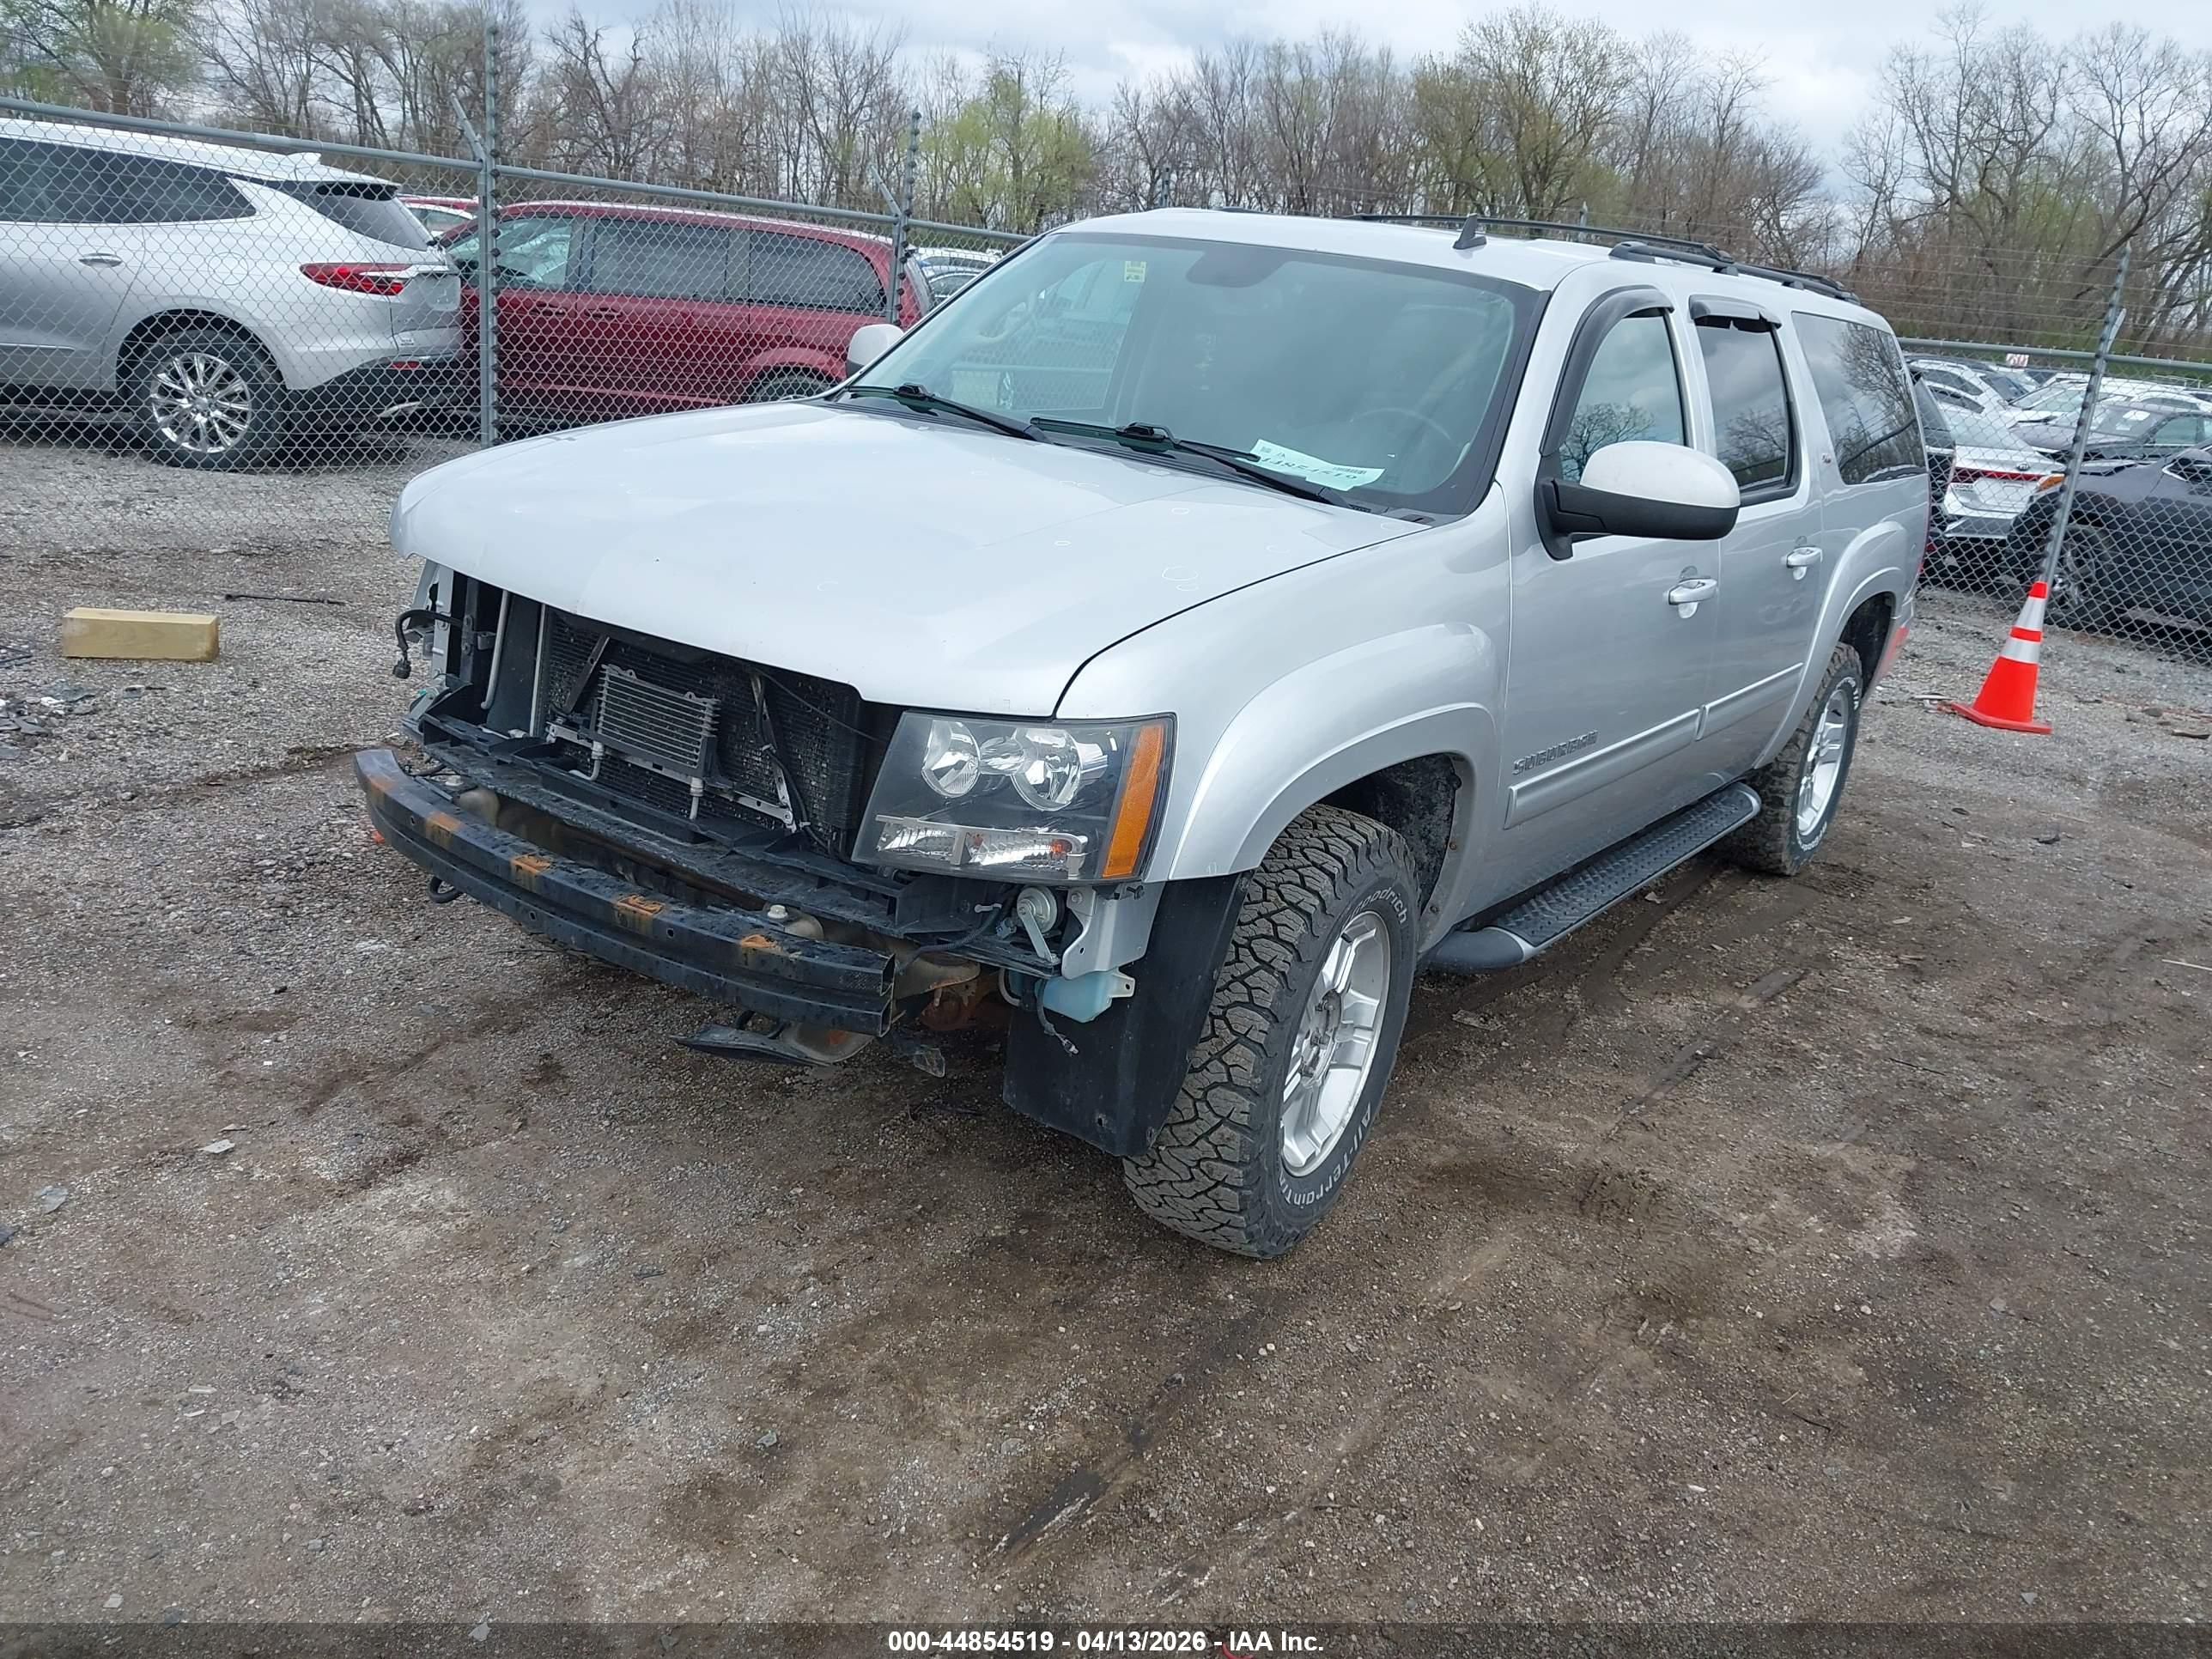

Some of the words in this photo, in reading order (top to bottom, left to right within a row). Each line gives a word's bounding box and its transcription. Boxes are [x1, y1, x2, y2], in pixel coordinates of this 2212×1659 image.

[1512, 729, 1598, 775] SUBURBAN
[1341, 886, 1408, 929] Goodrich
[1293, 1101, 1371, 1209] All-Terrain
